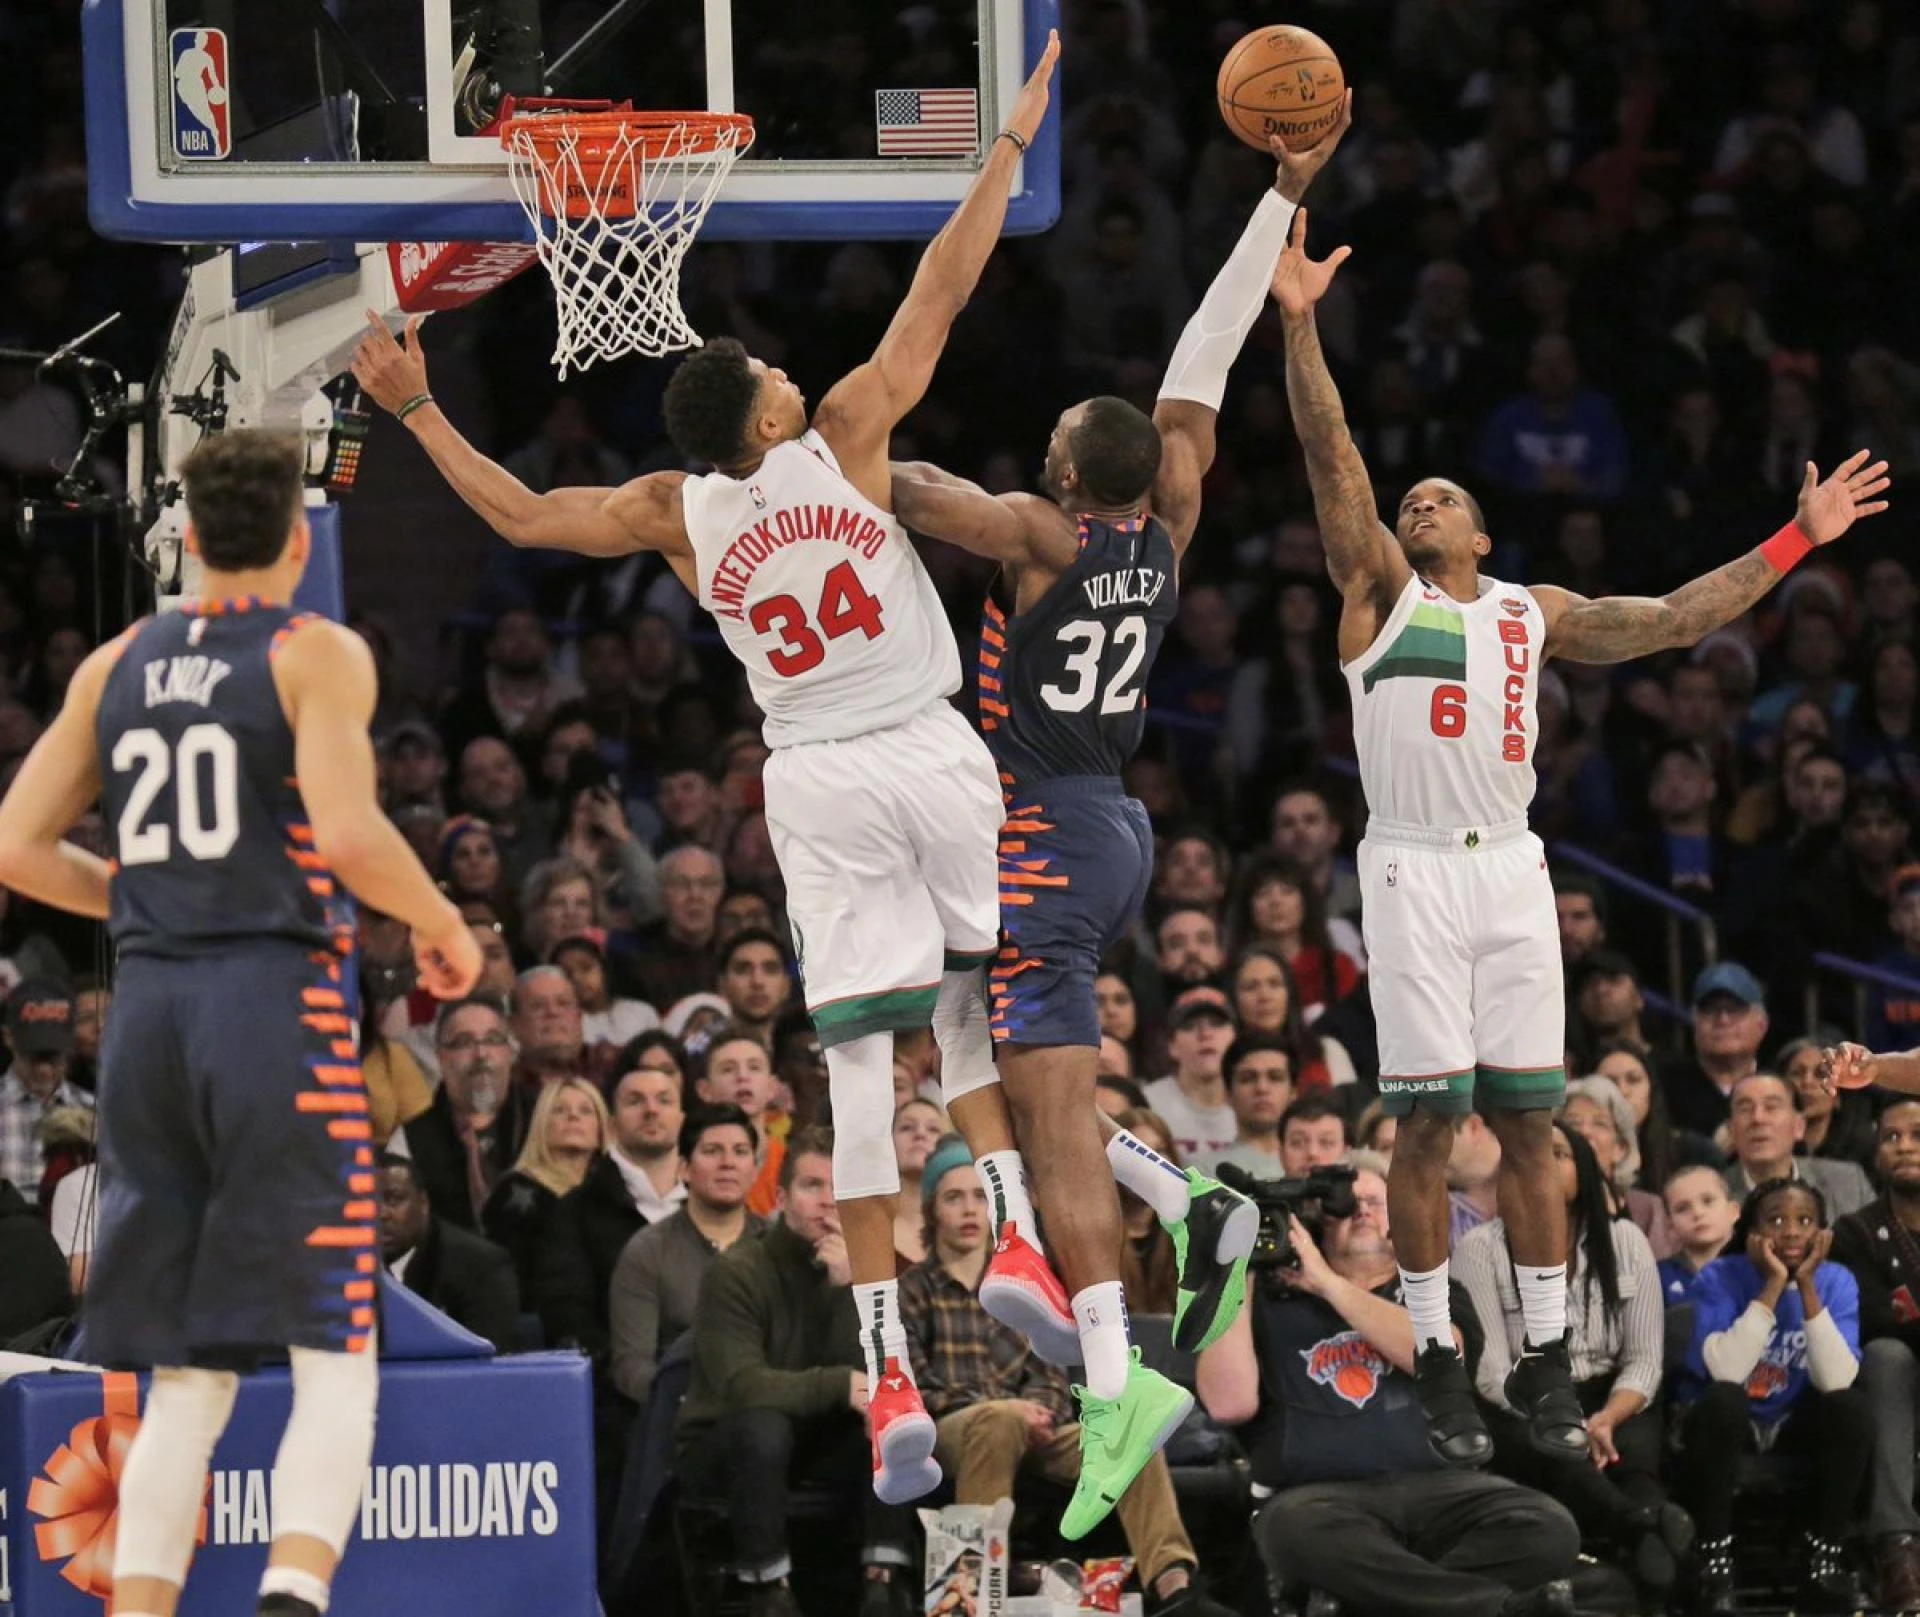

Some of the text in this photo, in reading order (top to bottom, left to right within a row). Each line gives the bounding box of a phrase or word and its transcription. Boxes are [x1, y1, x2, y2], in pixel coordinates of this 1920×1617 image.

[181, 130, 209, 151] NBA
[711, 504, 886, 622] ANTETOKOUNMPO
[1083, 568, 1166, 610] VONLEH
[749, 559, 885, 678] 34
[144, 655, 232, 708] KNOX
[1040, 615, 1147, 715] 32
[1497, 619, 1529, 762] BUCKS
[1430, 684, 1468, 738] 6
[112, 723, 240, 866] 20
[360, 1460, 559, 1541] HOLIDAYS
